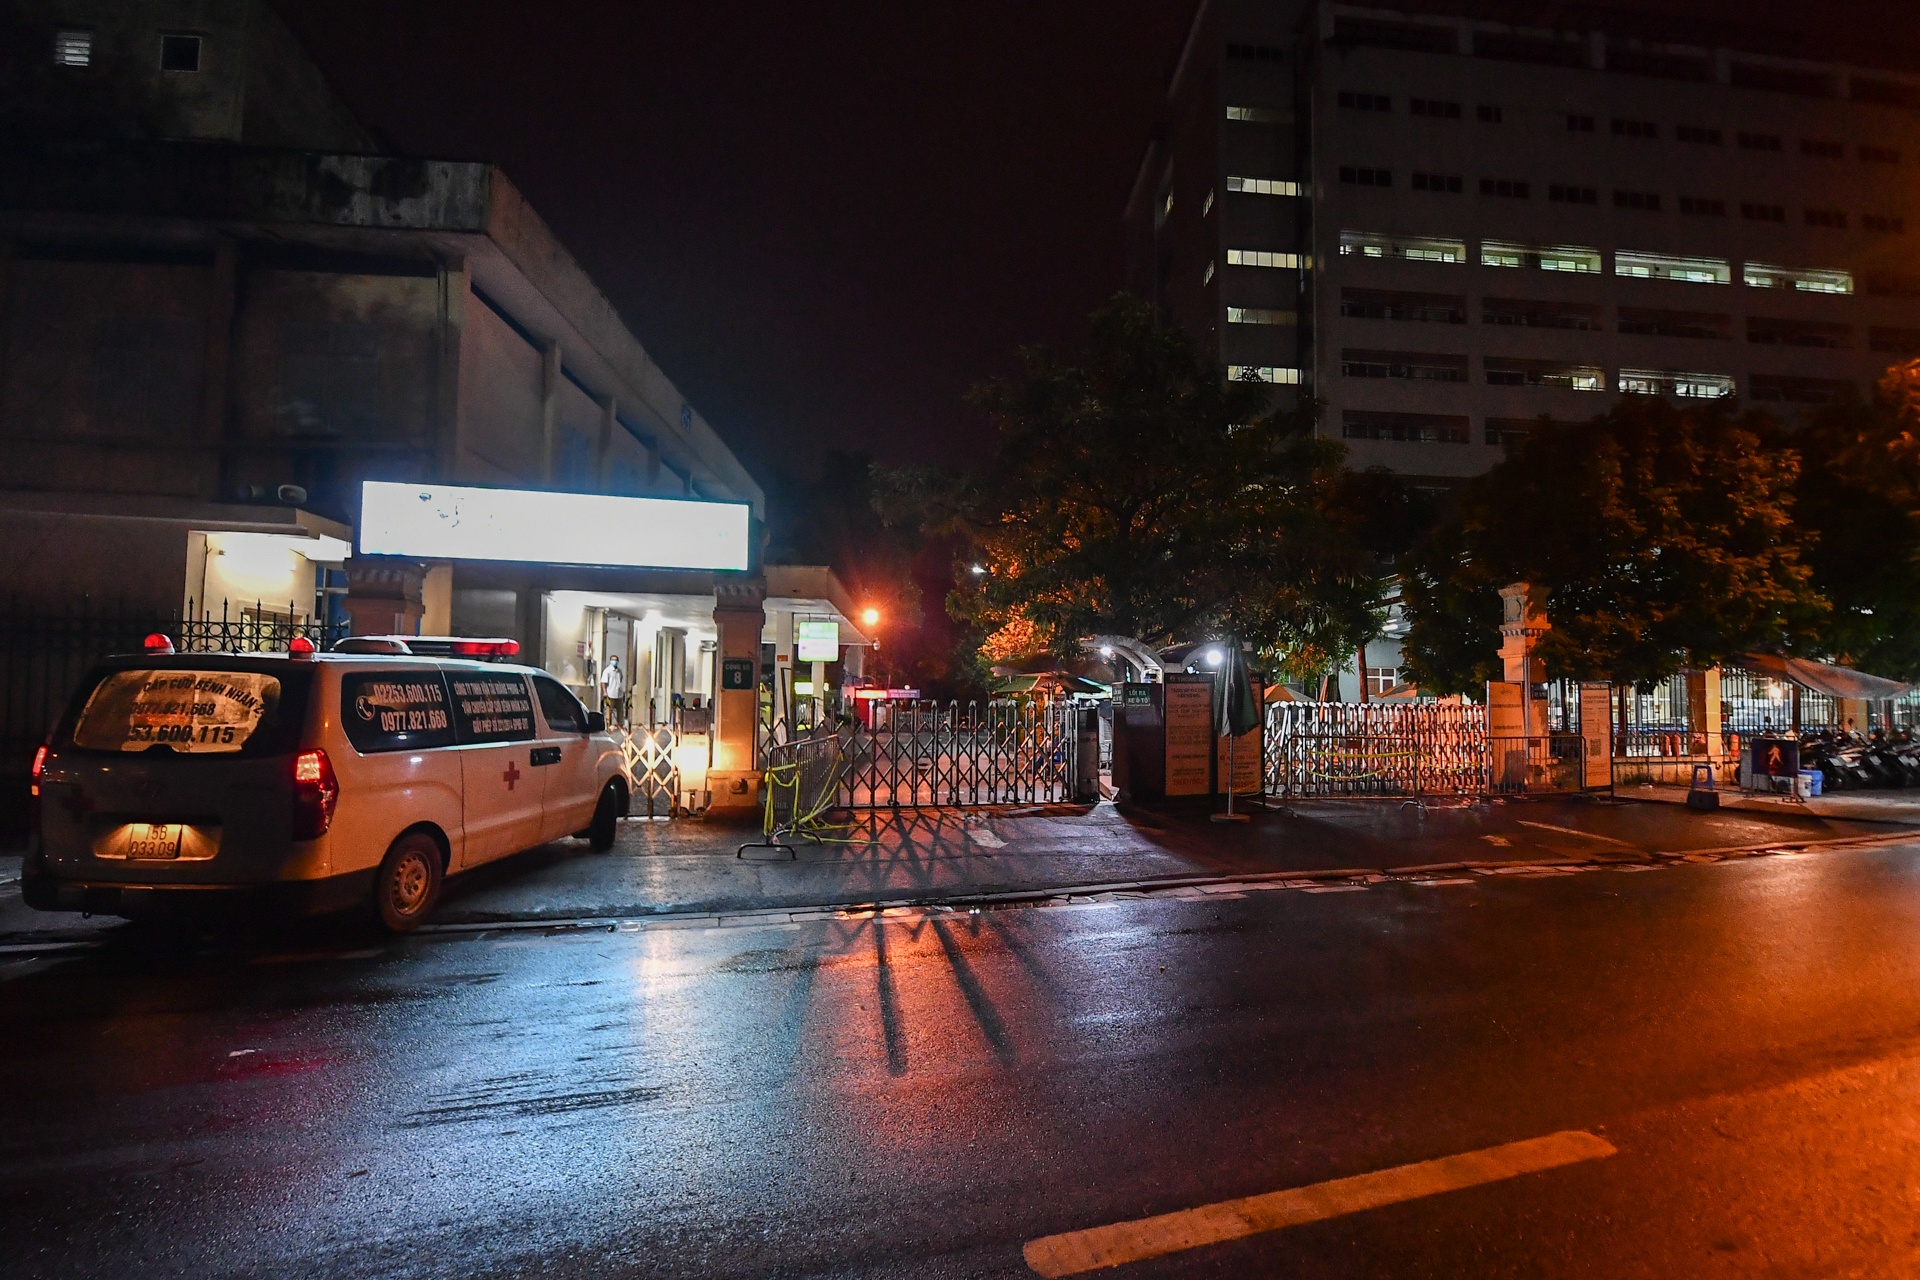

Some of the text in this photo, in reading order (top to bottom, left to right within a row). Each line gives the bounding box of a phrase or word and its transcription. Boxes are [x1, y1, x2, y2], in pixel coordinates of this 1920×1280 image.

[733, 671, 742, 684] 8
[194, 677, 227, 696] BỆNH
[225, 685, 259, 708] NHÂN
[373, 683, 443, 703] 02253.600.115
[381, 710, 448, 732] 0977.821.668
[145, 825, 168, 840] 15B
